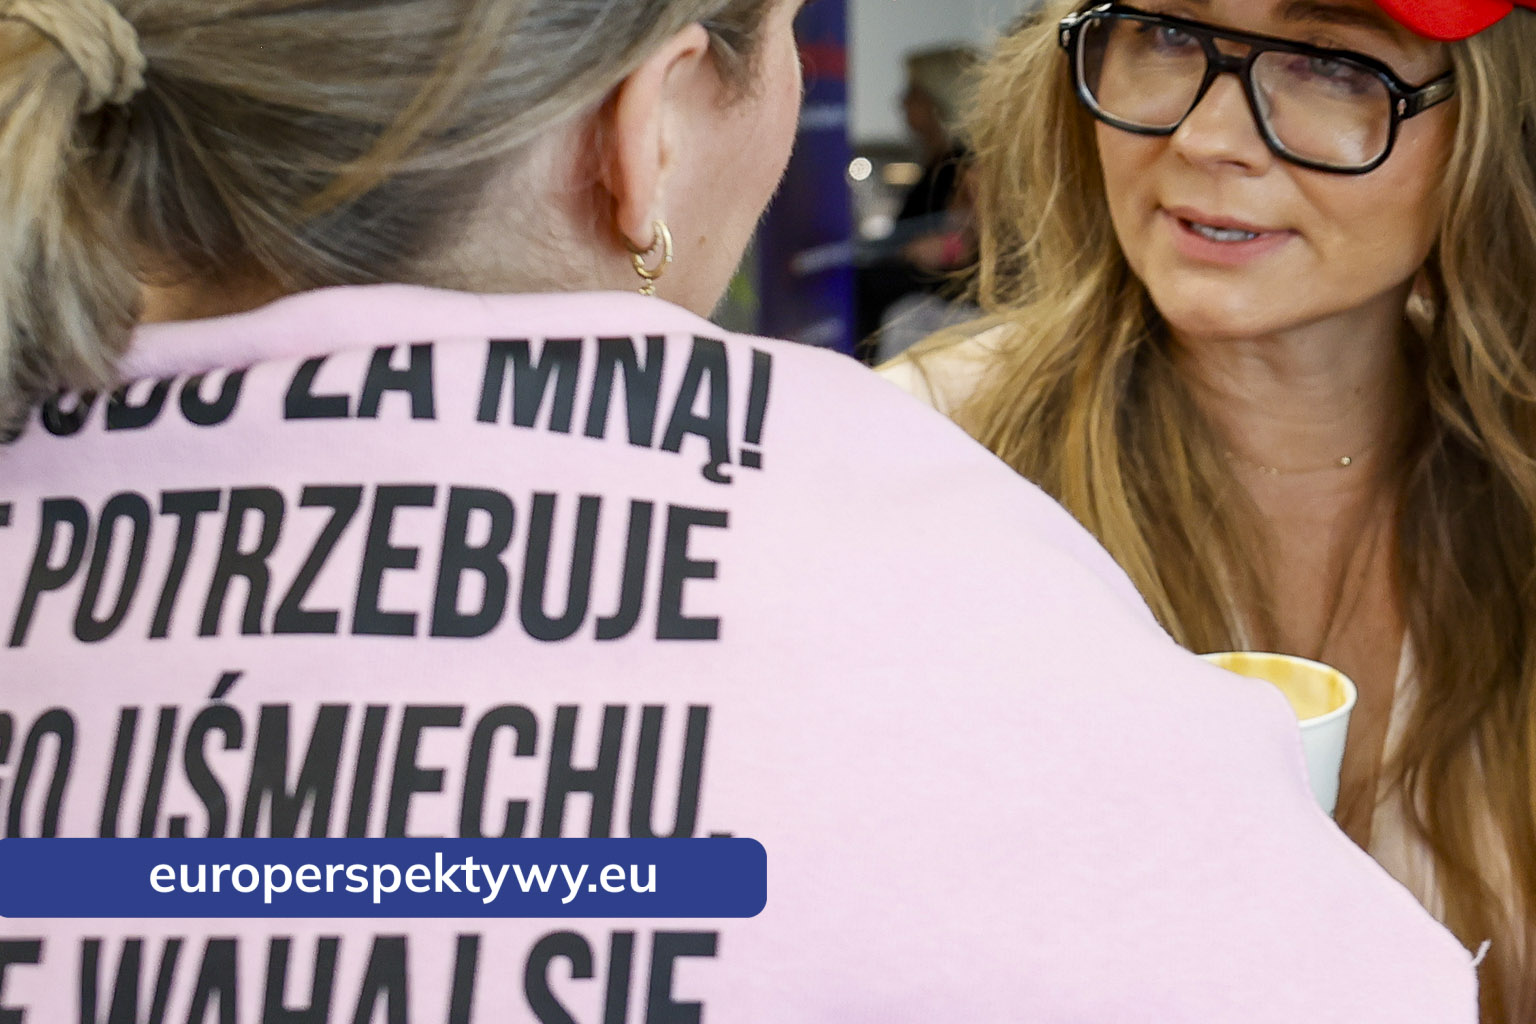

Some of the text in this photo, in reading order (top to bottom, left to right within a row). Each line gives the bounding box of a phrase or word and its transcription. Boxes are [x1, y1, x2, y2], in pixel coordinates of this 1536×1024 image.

[476, 333, 775, 484] MNĄ!
[8, 484, 731, 648] POTRZEBUJE
[99, 670, 733, 838] UŚMIECHU
